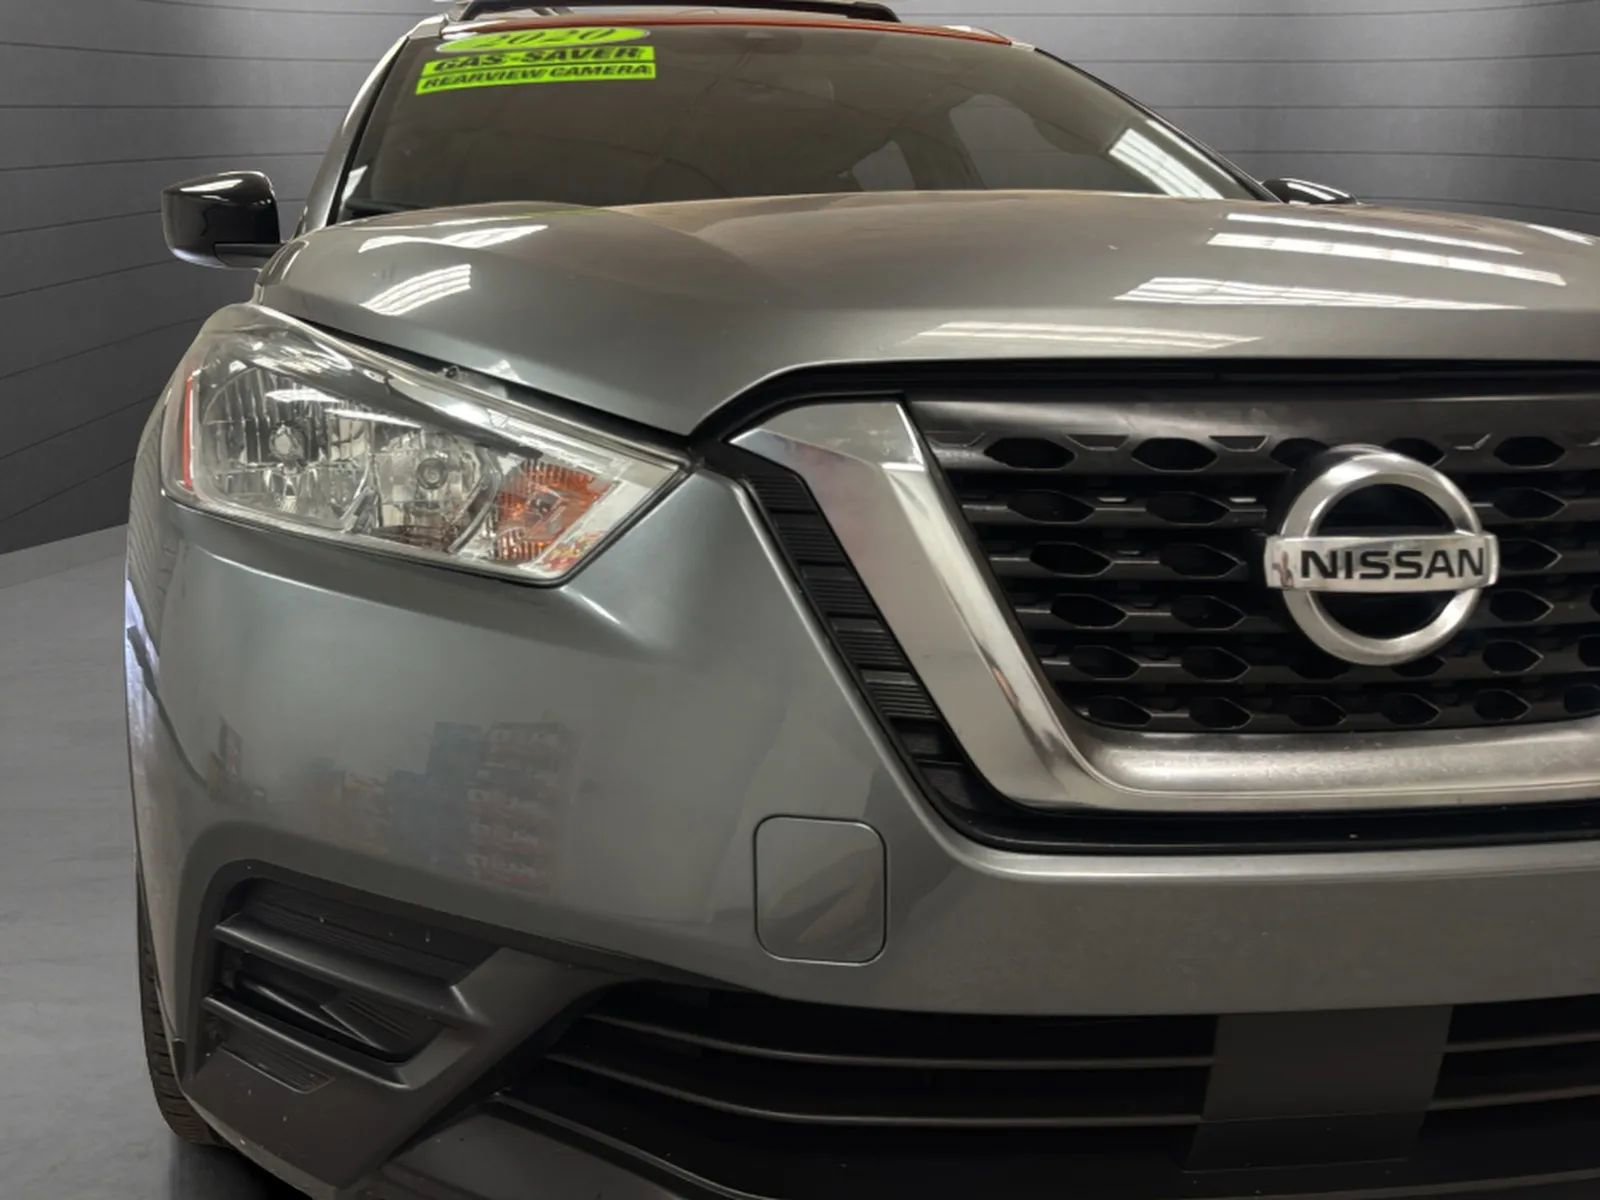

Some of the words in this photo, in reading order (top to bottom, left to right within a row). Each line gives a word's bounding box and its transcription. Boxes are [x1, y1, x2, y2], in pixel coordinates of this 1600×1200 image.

[473, 28, 617, 48] 2020
[424, 68, 543, 89] REARVIEW
[549, 64, 648, 78] CAMERA
[1301, 547, 1484, 580] NISSAN
